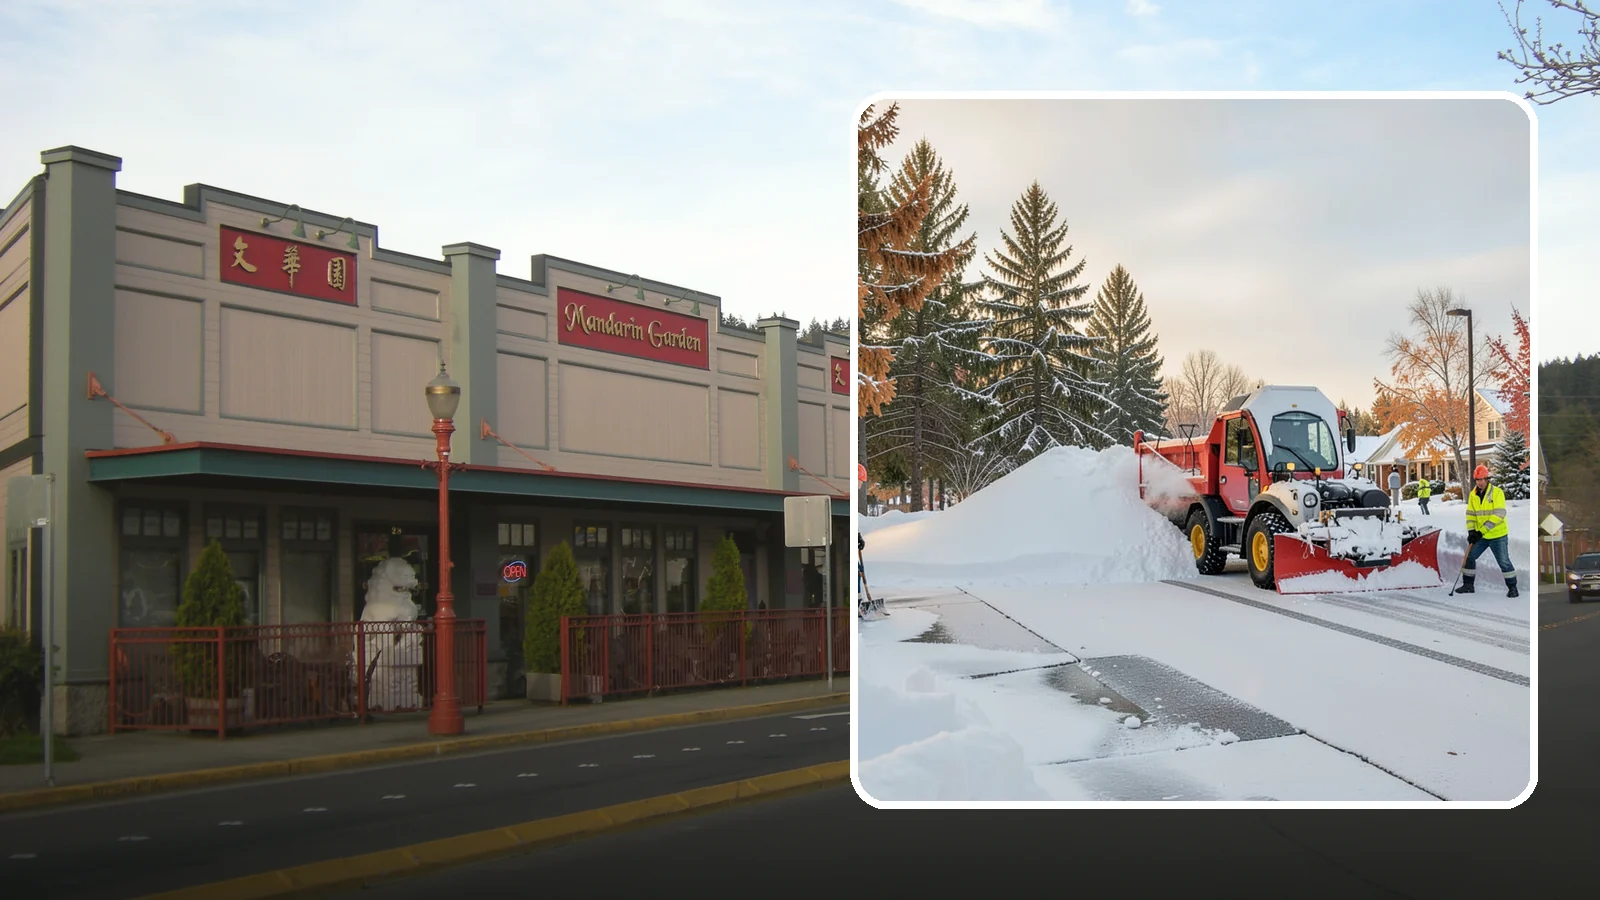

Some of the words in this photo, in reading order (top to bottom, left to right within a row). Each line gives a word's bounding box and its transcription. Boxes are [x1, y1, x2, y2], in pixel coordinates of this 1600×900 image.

[564, 302, 644, 341] Mandarin
[647, 320, 702, 352] Garden
[834, 363, 846, 386] 文
[503, 565, 527, 578] OPEN
